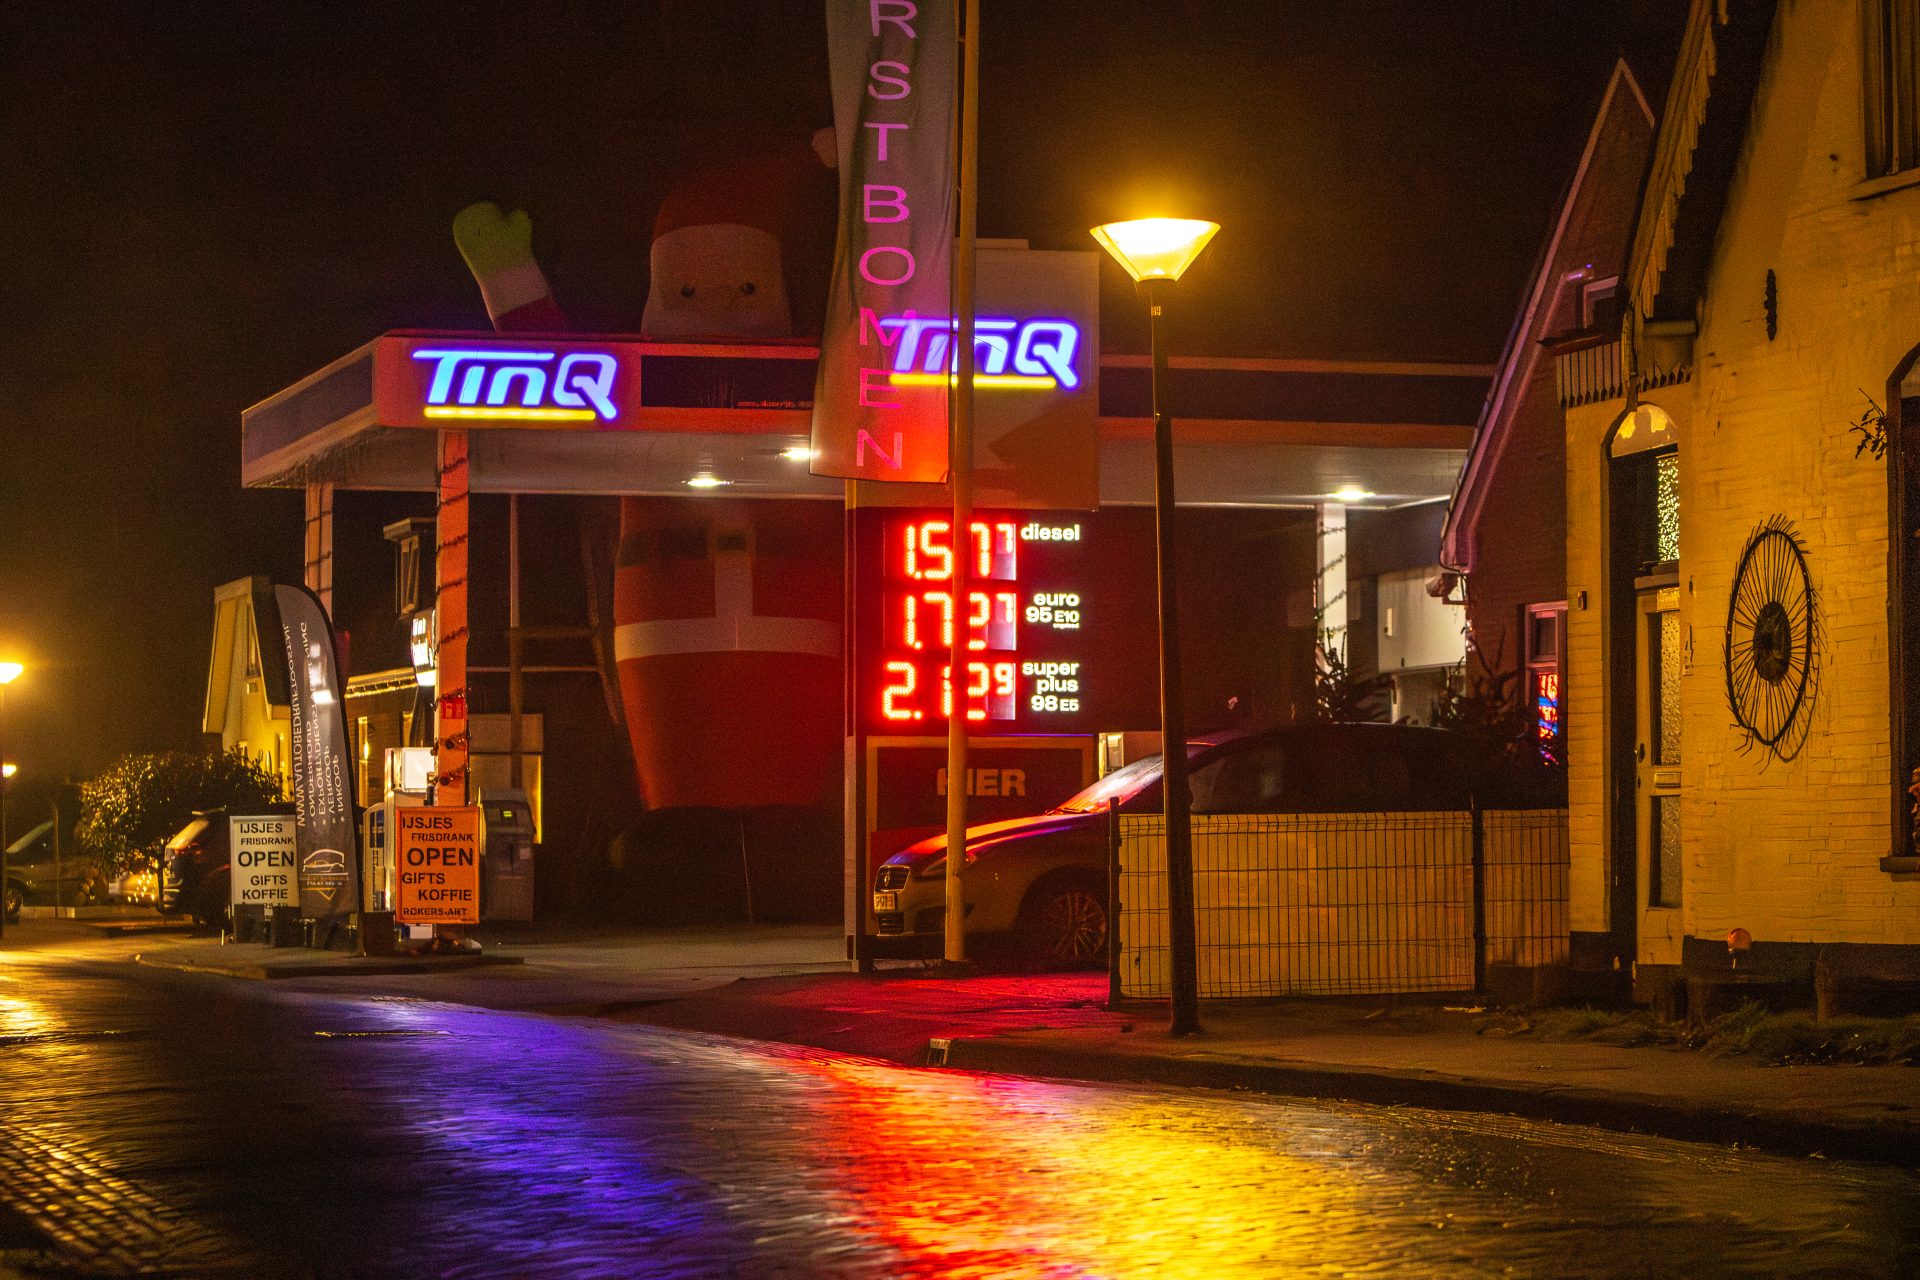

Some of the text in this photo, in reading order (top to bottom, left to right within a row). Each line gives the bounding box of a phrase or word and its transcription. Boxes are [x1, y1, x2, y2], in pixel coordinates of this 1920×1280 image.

[412, 350, 618, 420] TinQ
[1021, 523, 1080, 541] diesel
[1033, 593, 1080, 606] euro
[1026, 606, 1080, 623] 95 E10
[1022, 662, 1080, 679] super
[1037, 676, 1079, 694] plus
[1031, 695, 1079, 711] 98 E5
[240, 822, 283, 834] IJSJES
[402, 816, 453, 829] IJSJES
[240, 837, 295, 846] FRISDRANK
[411, 832, 474, 842] FRISDRANK
[237, 851, 295, 868] OPEN
[406, 847, 474, 867] OPEN
[250, 874, 288, 886] GIFTS
[401, 872, 446, 885] GIFTS
[242, 888, 289, 900] KOFFIE
[418, 889, 473, 901] KOFFIE
